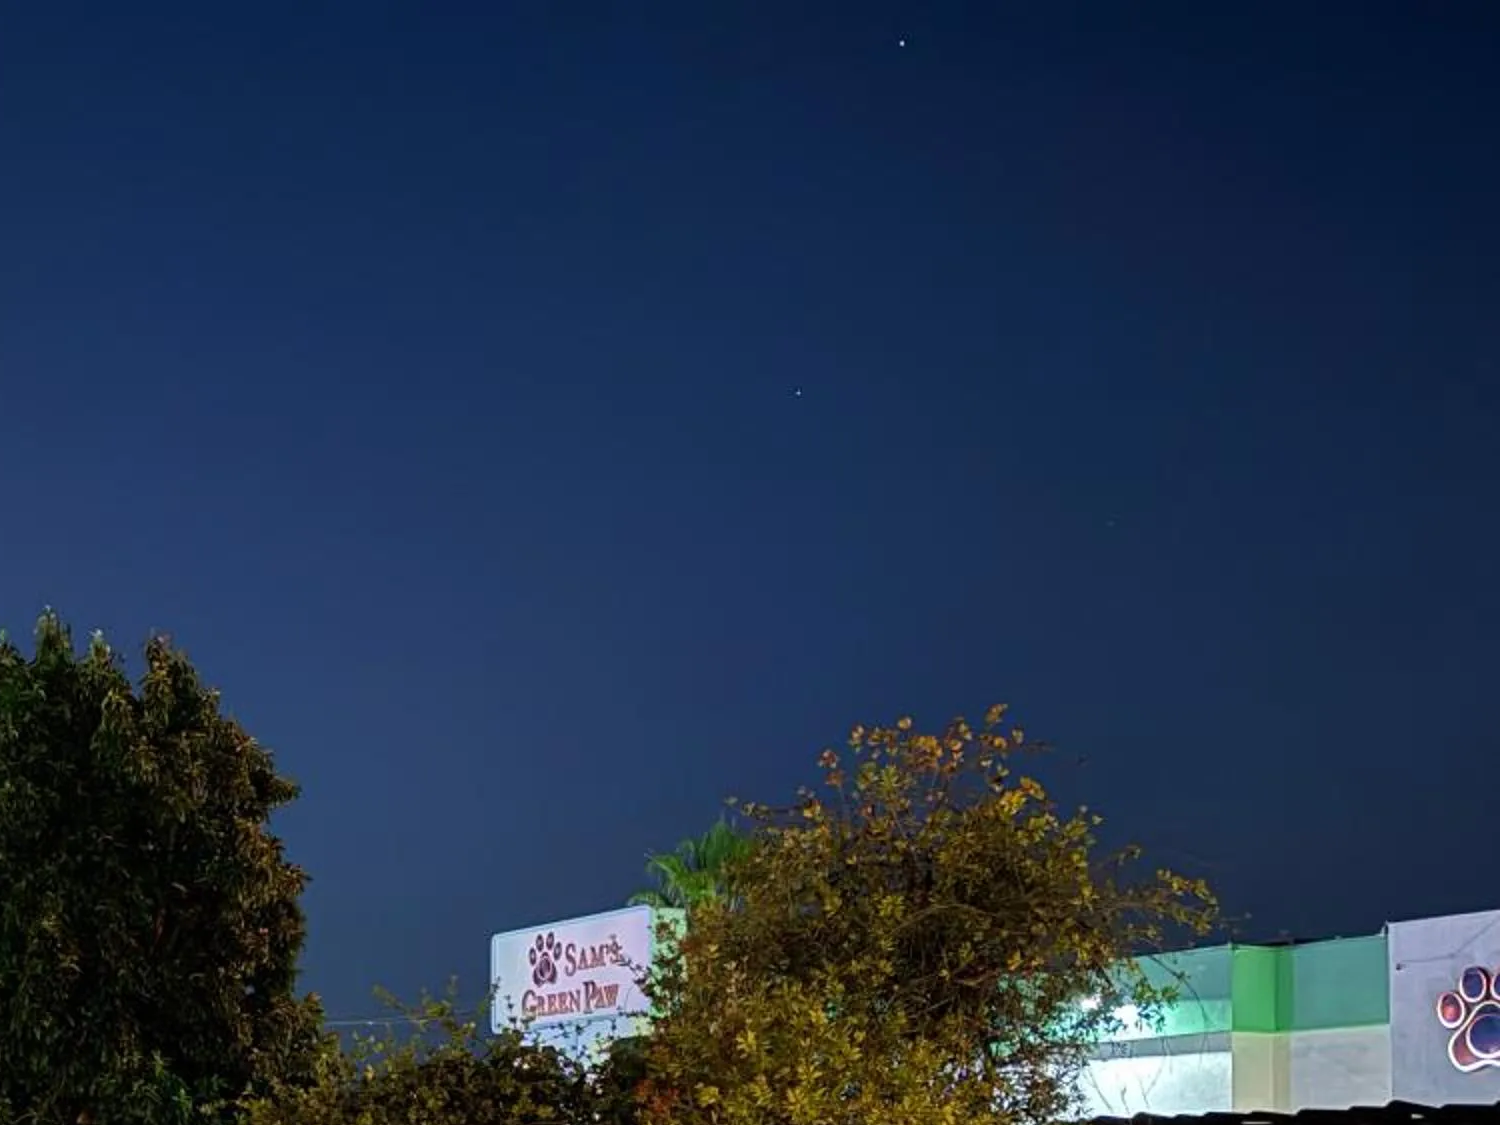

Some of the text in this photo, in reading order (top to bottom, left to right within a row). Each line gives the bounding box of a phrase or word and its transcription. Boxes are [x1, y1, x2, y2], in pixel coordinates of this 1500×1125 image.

[564, 941, 622, 977] SAM'S
[521, 980, 619, 1017] GREEN PAW
